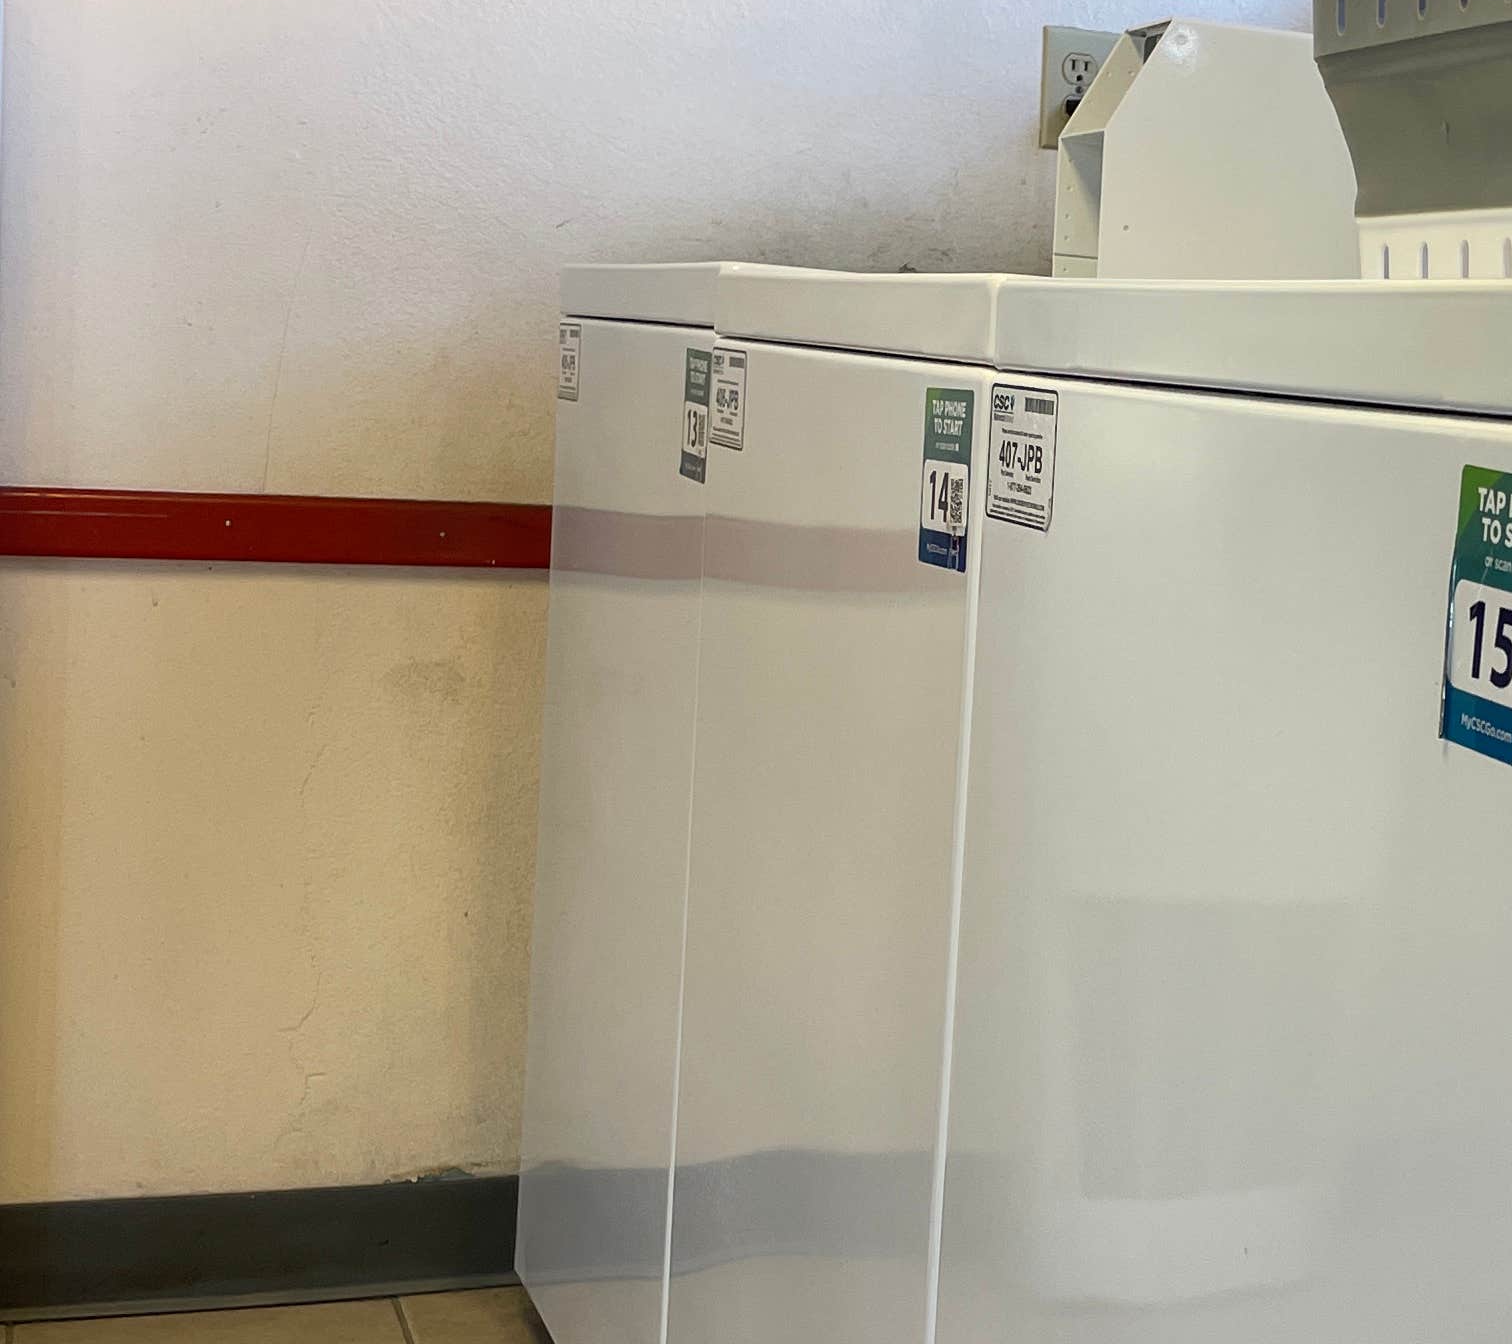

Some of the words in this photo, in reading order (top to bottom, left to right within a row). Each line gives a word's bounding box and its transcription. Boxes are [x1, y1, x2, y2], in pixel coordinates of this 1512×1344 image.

[932, 399, 944, 415] TAP
[945, 401, 966, 419] PHONE
[993, 393, 1010, 410] CSC
[688, 409, 697, 448] 13
[934, 418, 942, 434] TO
[943, 419, 963, 436] START
[999, 440, 1043, 474] 407-JPB
[929, 470, 949, 523] 14
[1478, 487, 1506, 513] TAP
[1481, 517, 1502, 545] TO
[1485, 558, 1493, 568] or
[1494, 559, 1512, 573] scan
